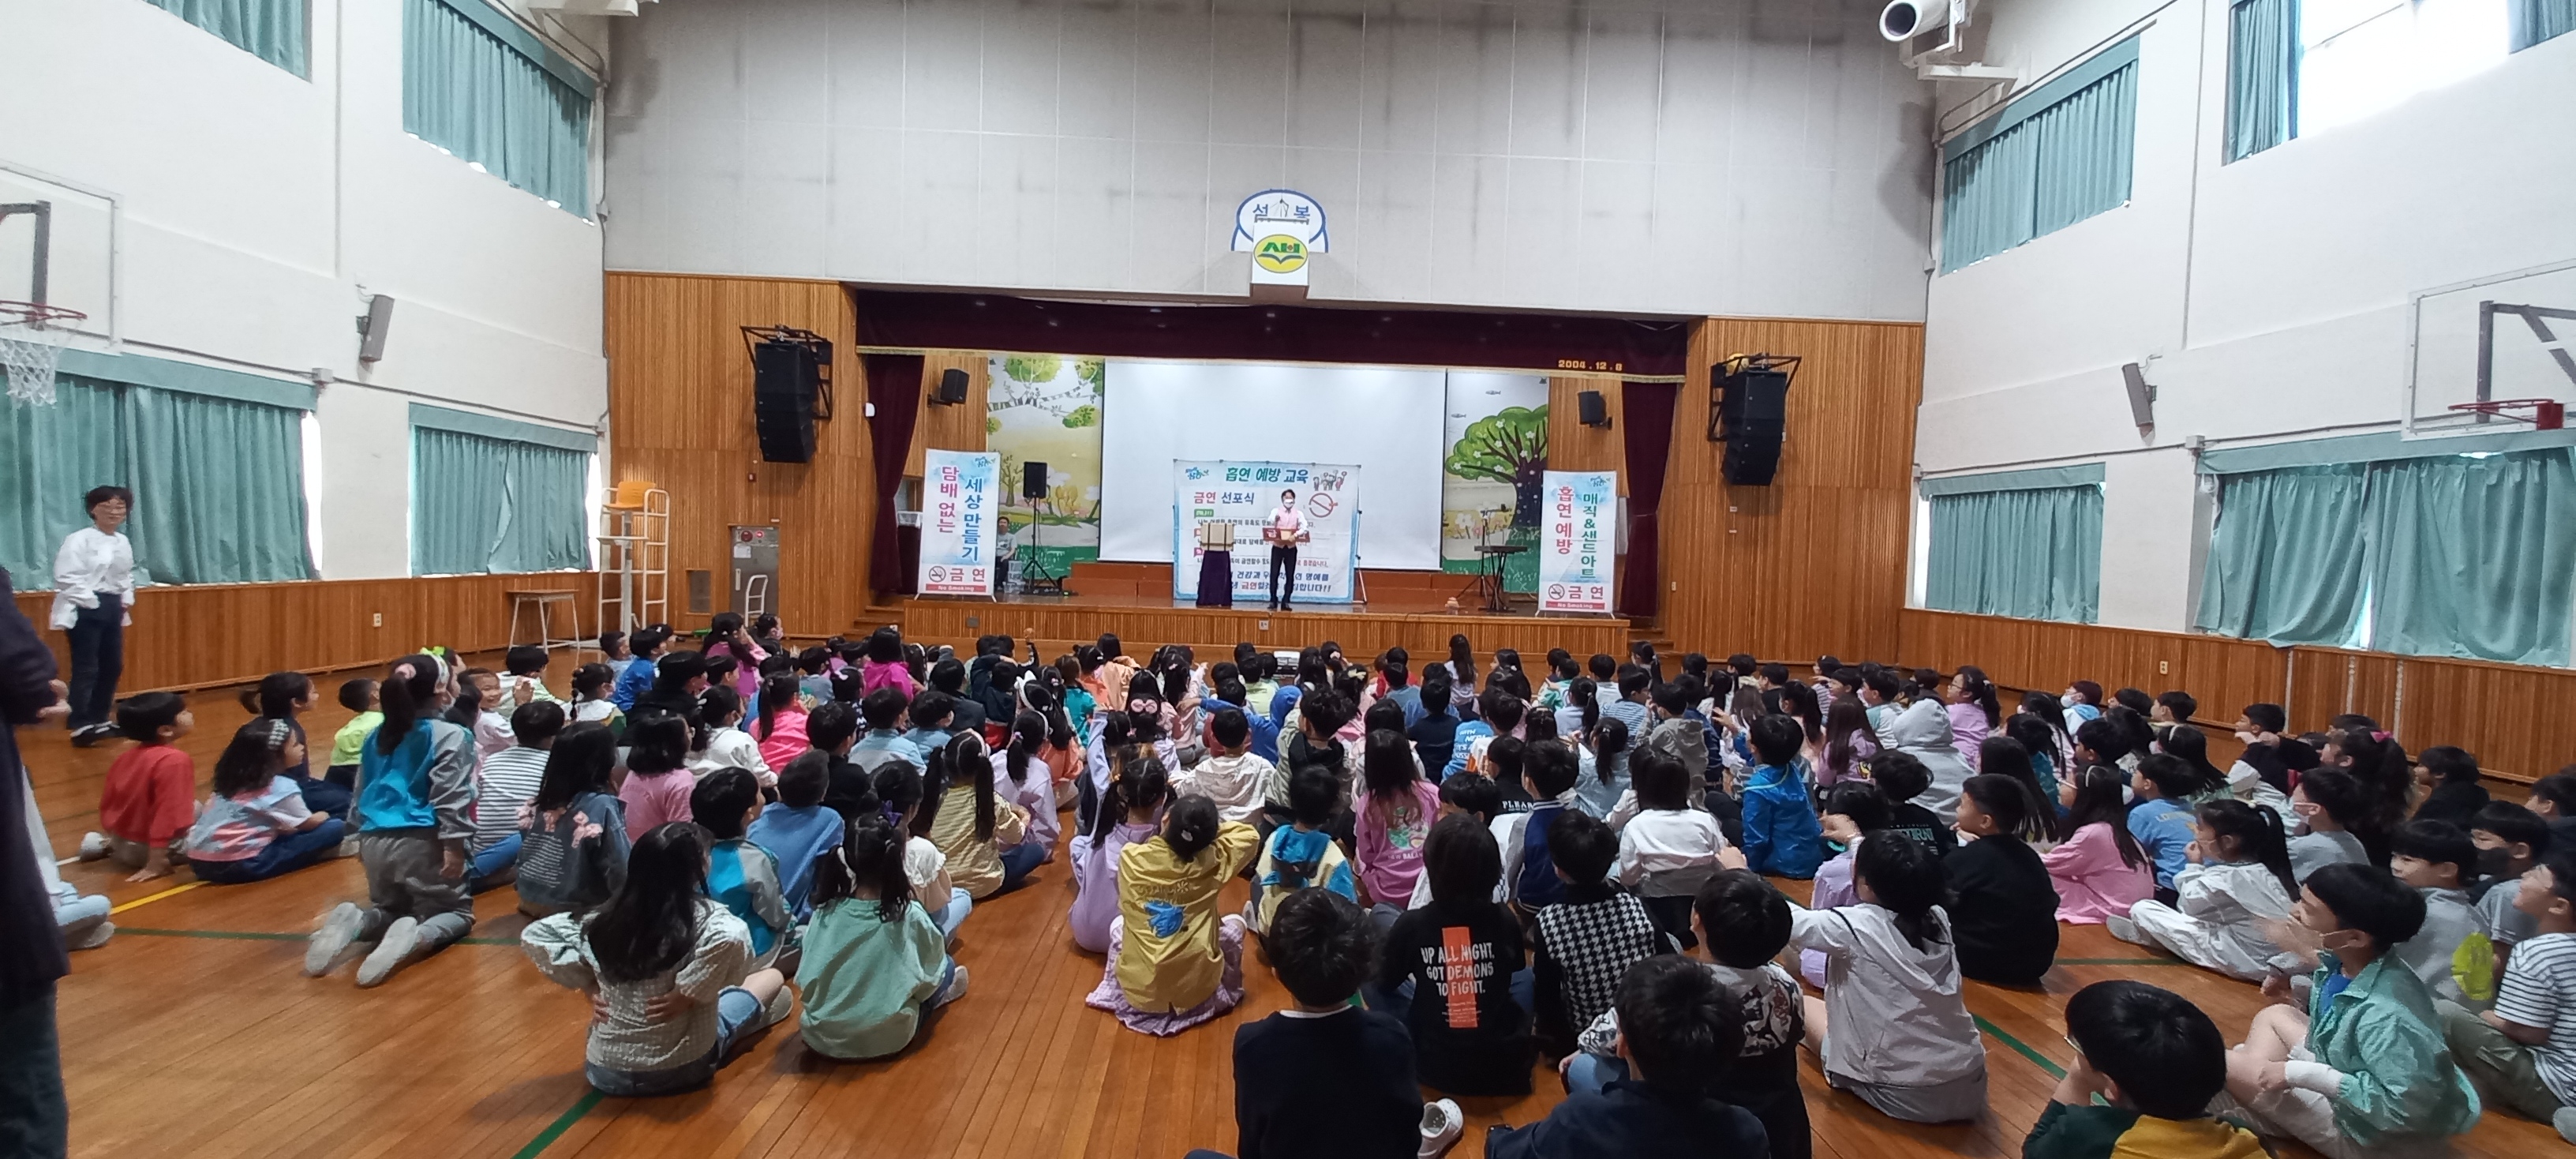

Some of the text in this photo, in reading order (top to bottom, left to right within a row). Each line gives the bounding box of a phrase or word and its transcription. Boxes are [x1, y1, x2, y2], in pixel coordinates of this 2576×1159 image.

[1226, 467, 1252, 482] 흡연
[1256, 467, 1282, 483] 예방
[1283, 469, 1309, 485] 교육
[937, 466, 960, 533] 담배 없는
[1193, 491, 1255, 505] 금연 선포식
[1555, 486, 1574, 555] 흡연 예방
[1421, 942, 1496, 965] UP ALL NIGHT.
[1426, 961, 1495, 981] GOT DEMONS
[1436, 980, 1486, 996] TO FIGHT.
